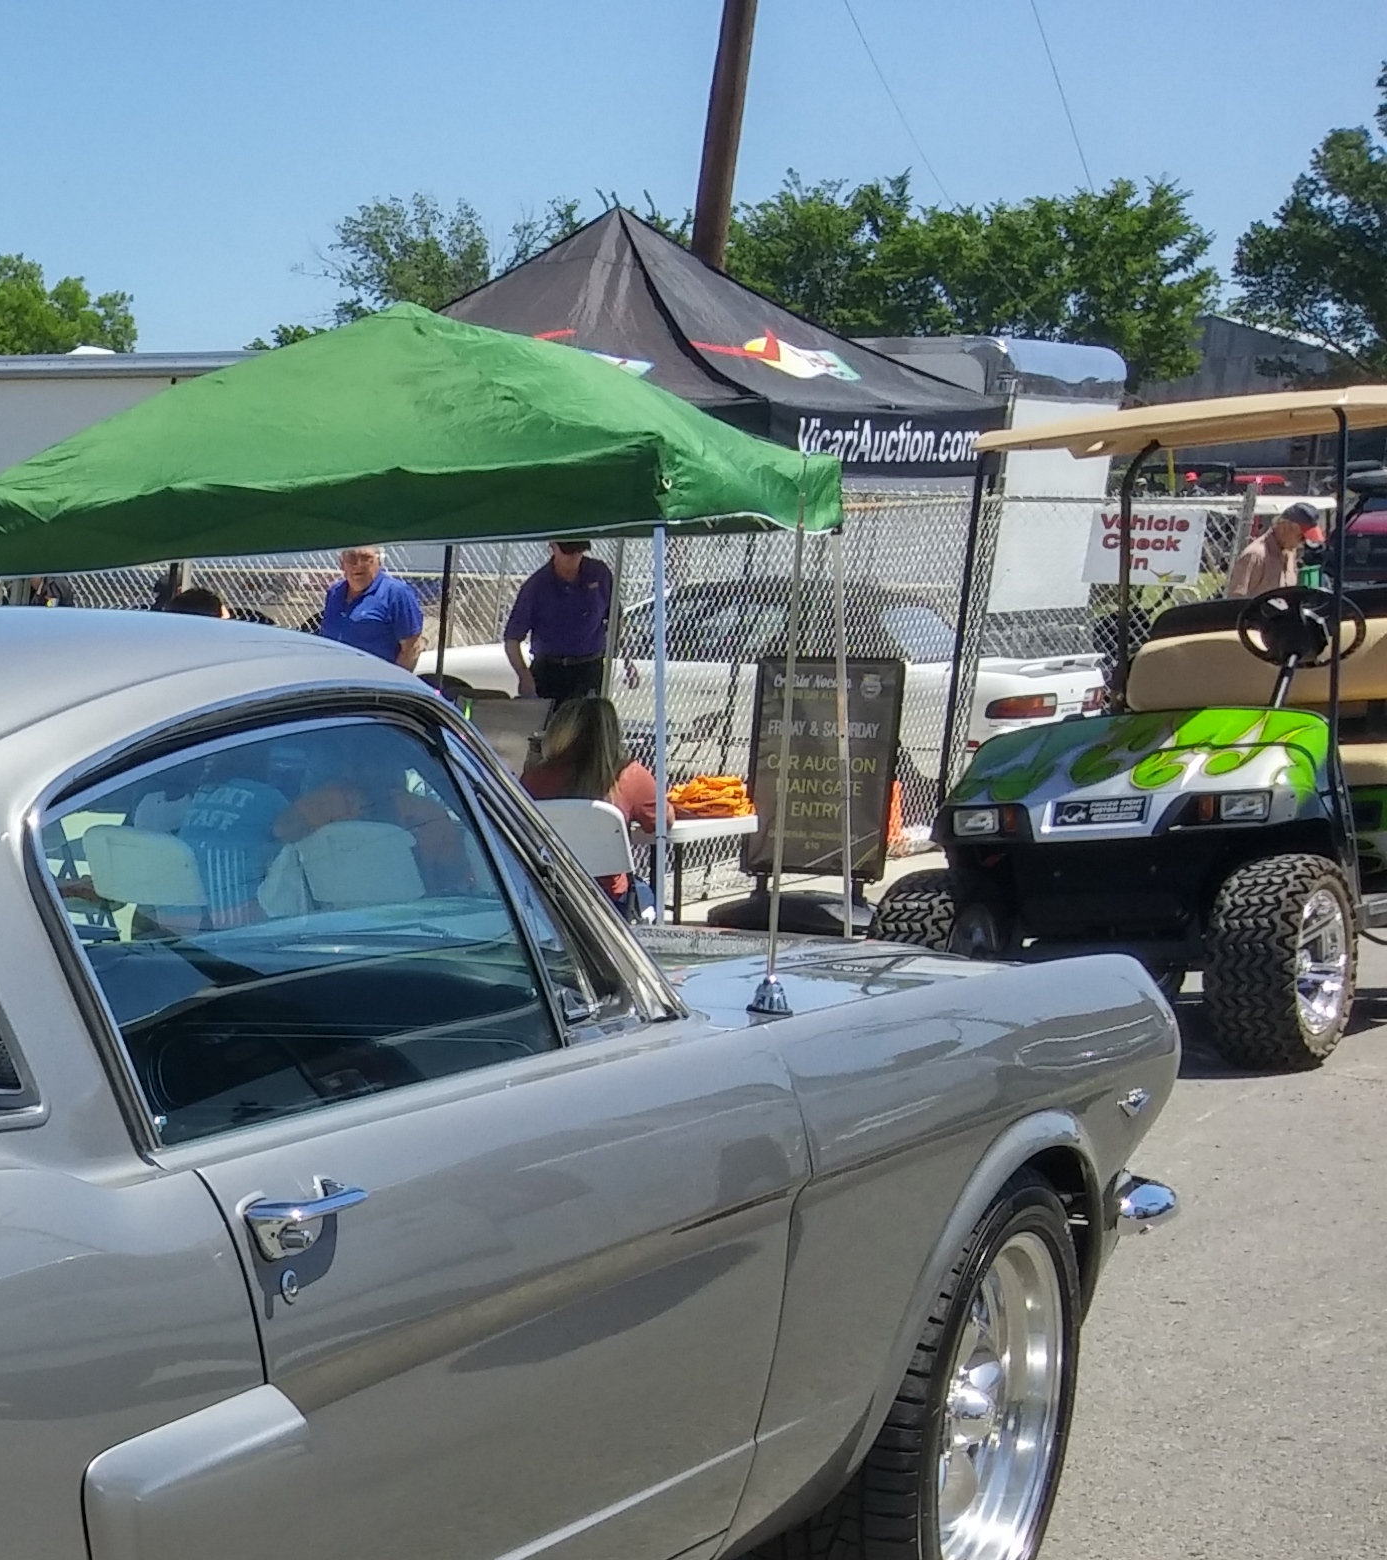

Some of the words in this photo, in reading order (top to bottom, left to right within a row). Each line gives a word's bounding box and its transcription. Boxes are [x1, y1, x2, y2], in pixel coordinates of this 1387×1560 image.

[768, 719, 807, 737] FRAY
[809, 720, 819, 737] &
[822, 721, 881, 739] SARDAY
[767, 753, 800, 771] CR
[803, 754, 877, 774] AUCON
[822, 780, 864, 797] GAE
[790, 801, 843, 820] ENTRY
